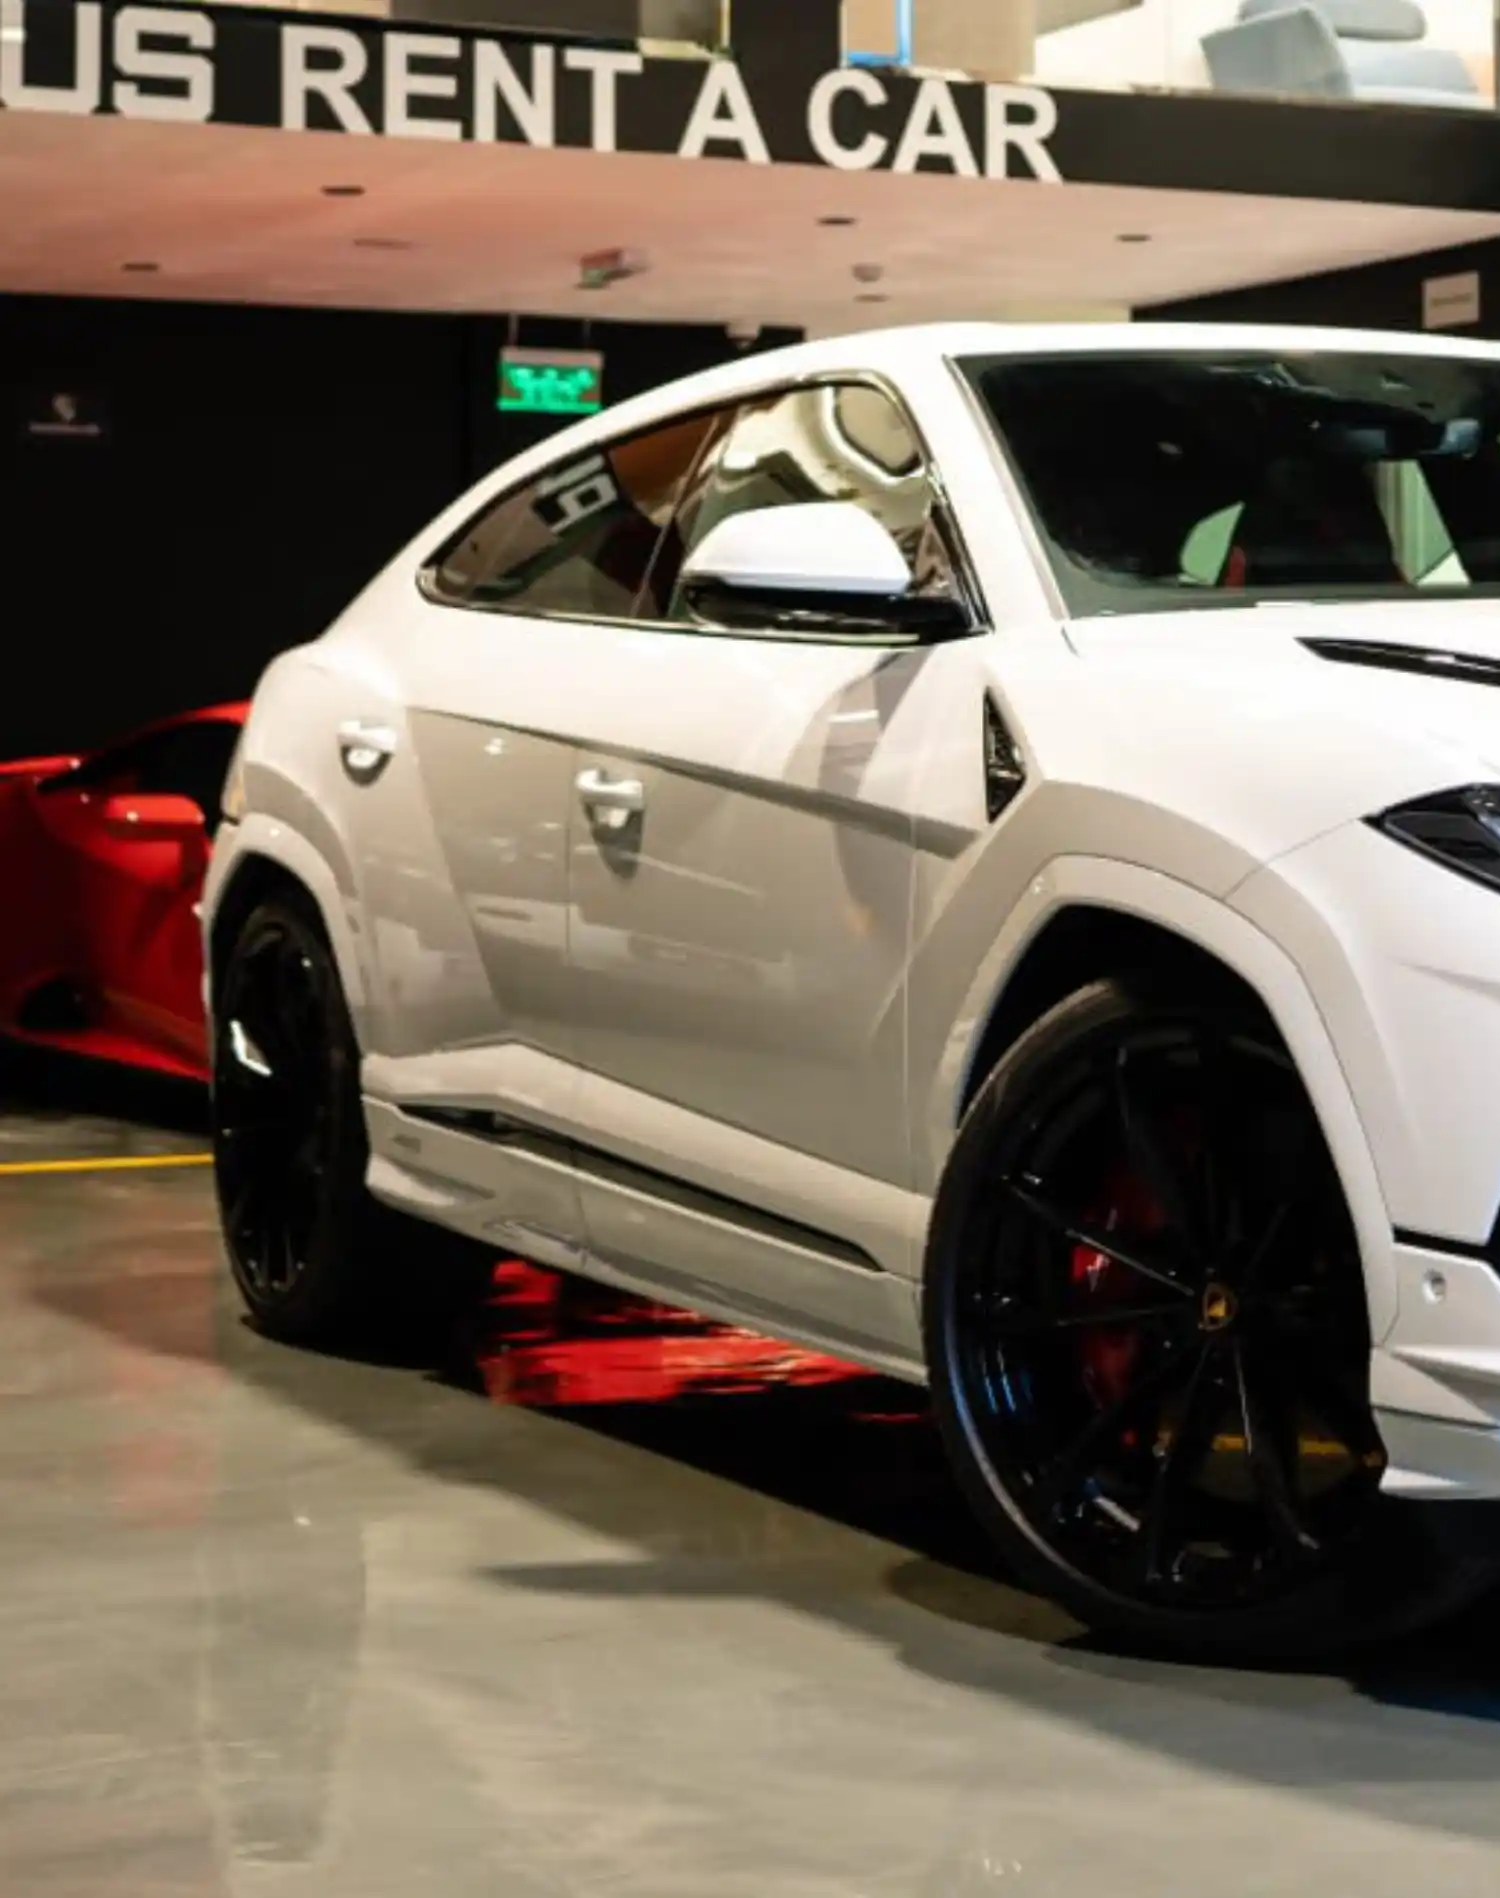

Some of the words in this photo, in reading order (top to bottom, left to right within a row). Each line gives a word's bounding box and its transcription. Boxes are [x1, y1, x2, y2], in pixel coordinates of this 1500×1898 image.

[0, 0, 215, 122] US
[281, 23, 643, 153] RENT
[678, 60, 772, 164] A
[807, 67, 1064, 184] CAR
